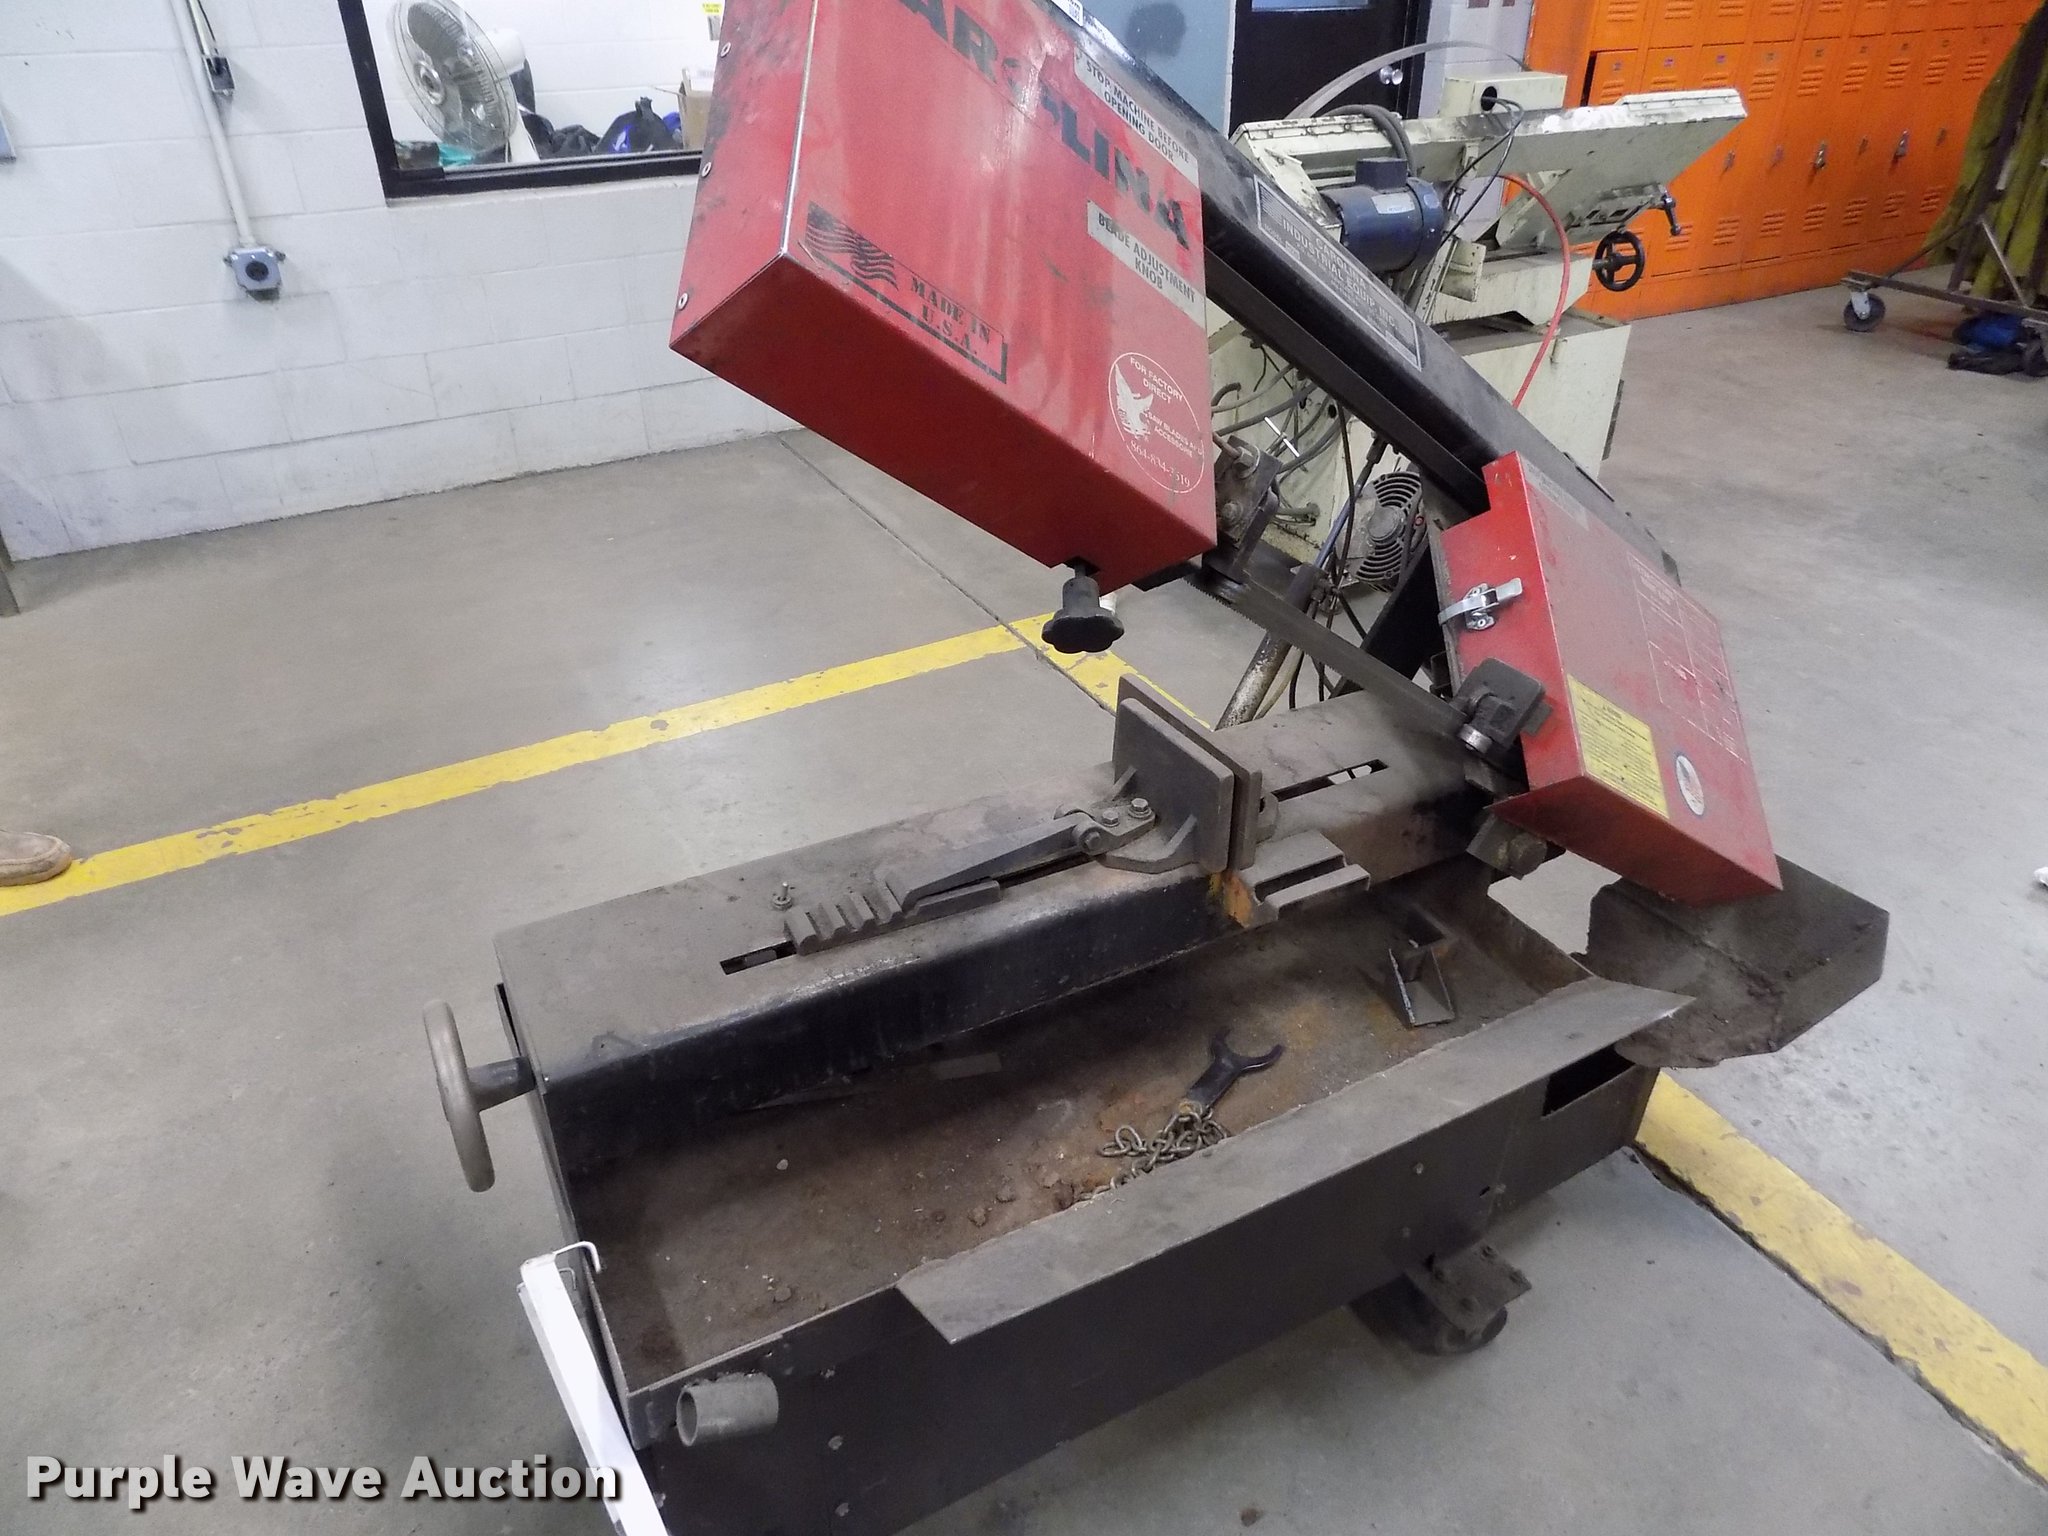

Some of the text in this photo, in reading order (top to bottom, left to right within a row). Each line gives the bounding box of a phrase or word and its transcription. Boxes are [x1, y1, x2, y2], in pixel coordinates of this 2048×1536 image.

[1086, 60, 1189, 164] STOP MACHINE BEFORE
[1104, 91, 1174, 163] OPENING DOOR
[1098, 212, 1196, 303] BLADE ADJUSTMENT
[1135, 257, 1163, 290] KNOB
[1282, 217, 1345, 281] INDUSTRIAL
[1315, 237, 1367, 291] CAROLINA
[911, 274, 991, 345] MADE IN
[922, 303, 978, 355] U.S.A.
[1130, 356, 1184, 402] FOR FACTORY
[1142, 377, 1172, 404] DIRECT
